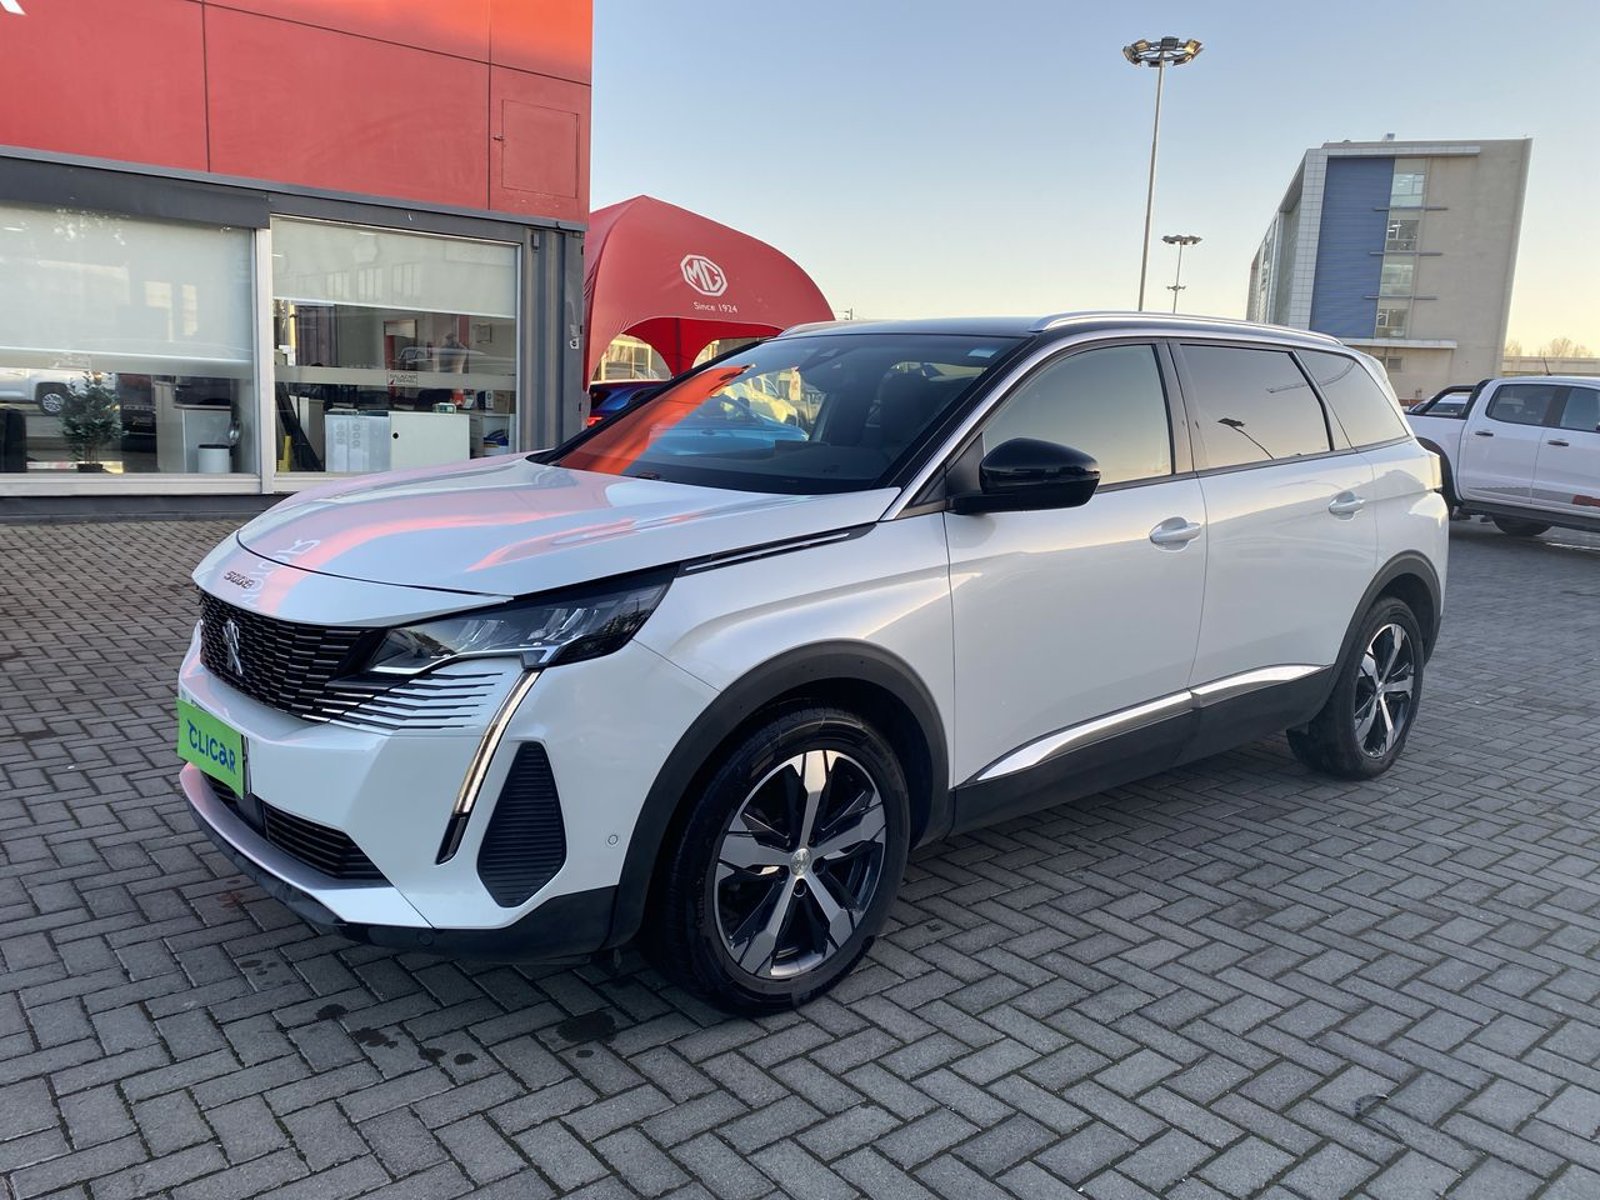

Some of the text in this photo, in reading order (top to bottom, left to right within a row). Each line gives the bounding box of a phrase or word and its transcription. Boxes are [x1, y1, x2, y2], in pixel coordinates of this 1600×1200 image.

[685, 258, 723, 291] MG
[693, 301, 738, 314] Since 1924
[223, 570, 256, 590] 5008
